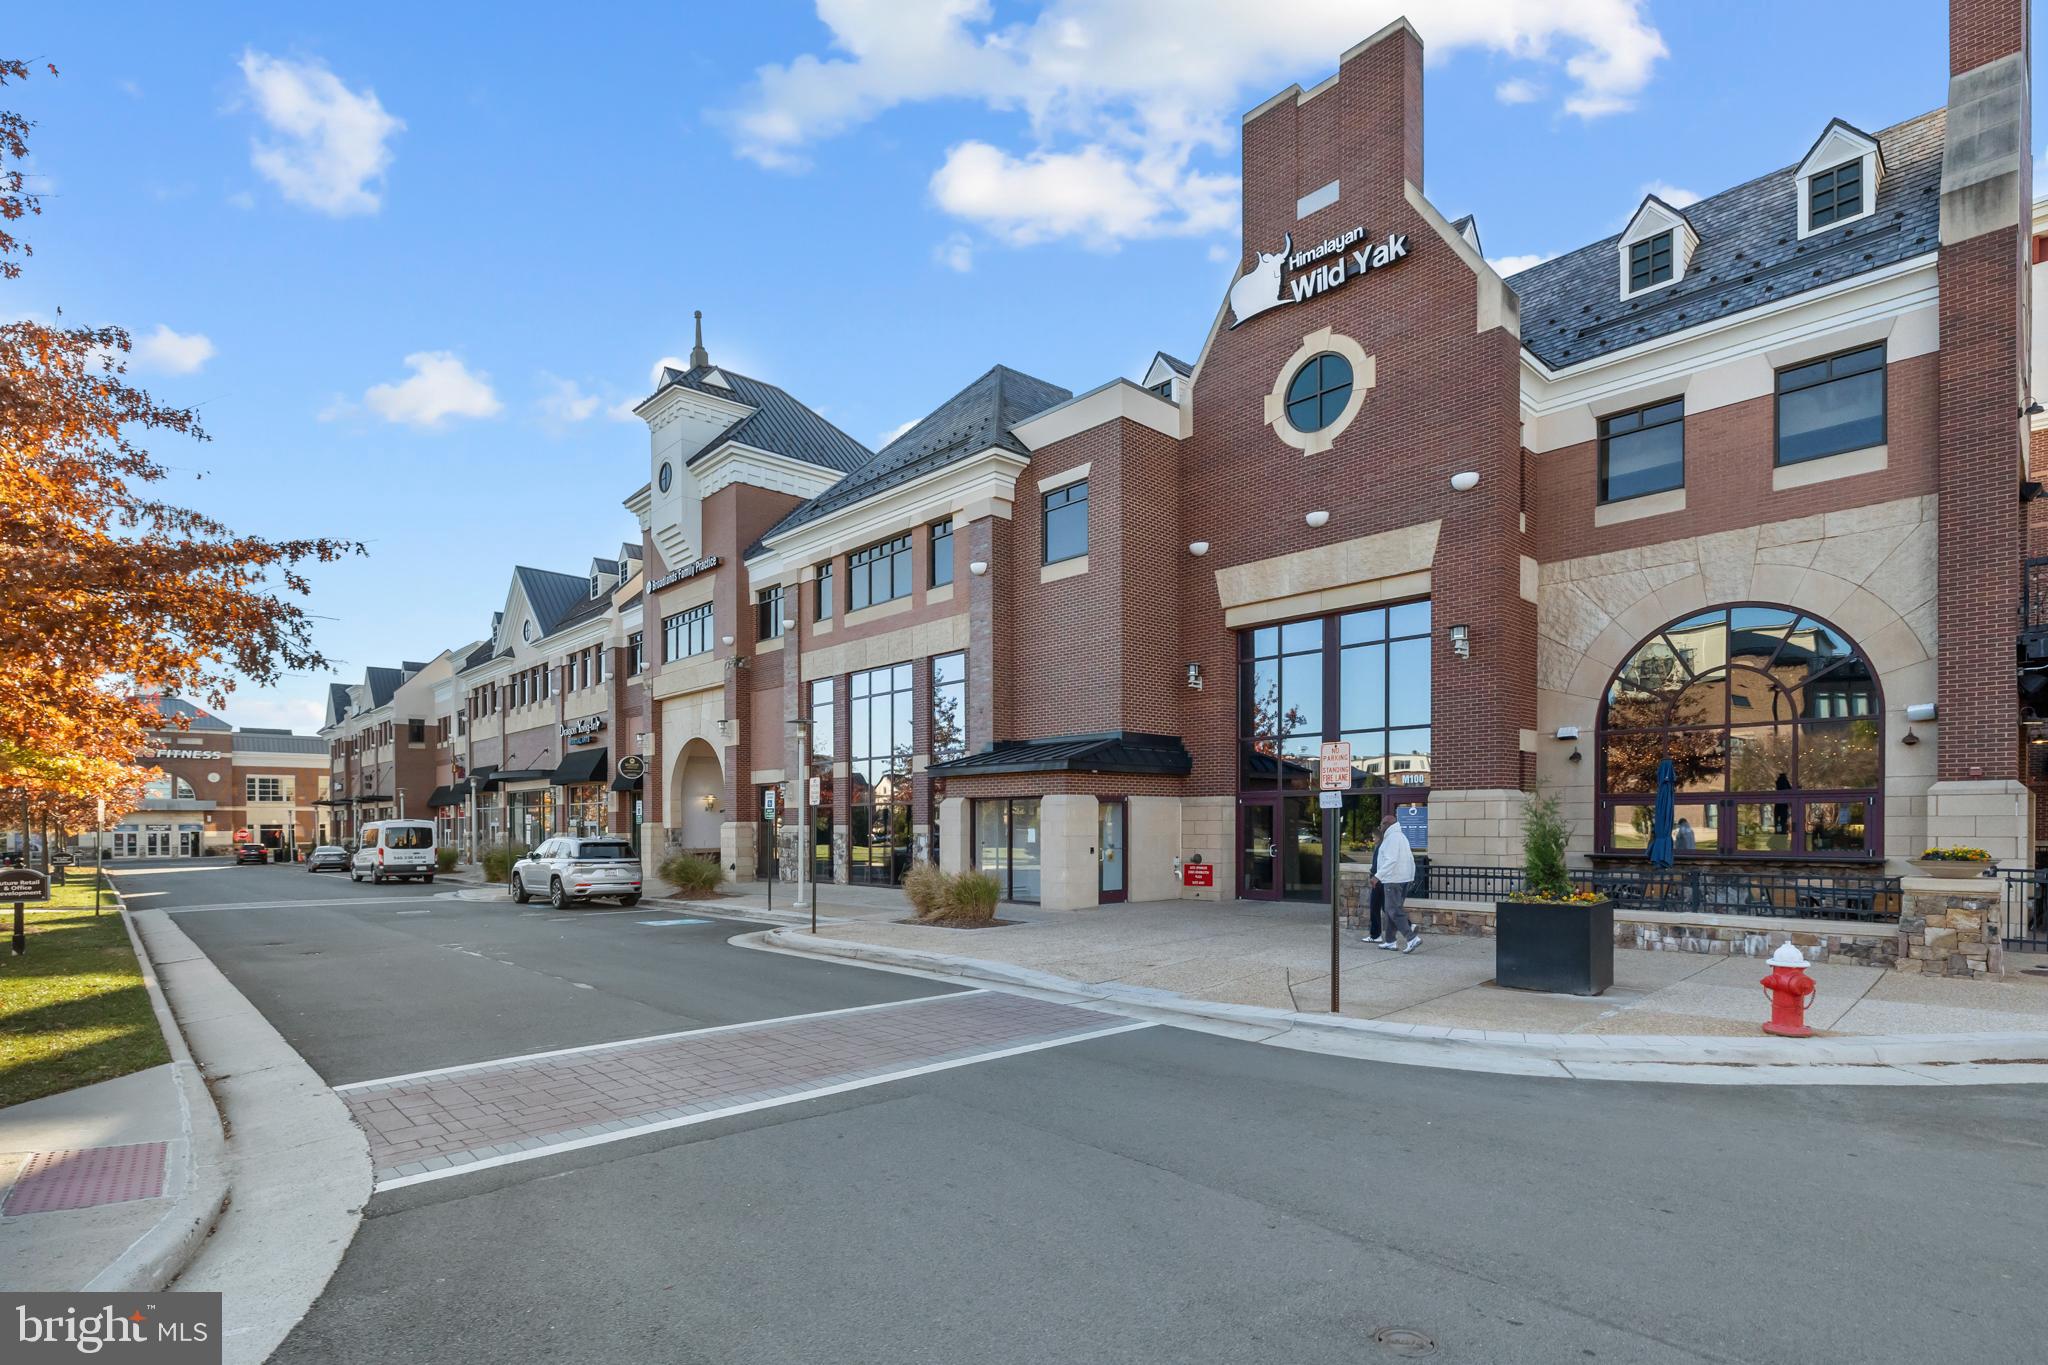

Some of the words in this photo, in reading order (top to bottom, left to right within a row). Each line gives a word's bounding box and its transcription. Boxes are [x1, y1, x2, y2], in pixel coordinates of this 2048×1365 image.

[1289, 226, 1364, 271] Himalayan
[1291, 258, 1346, 302] Wild
[1353, 234, 1408, 275] Yak
[678, 564, 695, 580] Family
[695, 555, 717, 573] Practice
[560, 724, 577, 738] Dragon
[156, 749, 222, 760] FITNESS
[1322, 766, 1349, 774] STANDING
[1322, 774, 1333, 782] FIRE
[1335, 773, 1349, 781] LANE
[1402, 774, 1424, 784] M100
